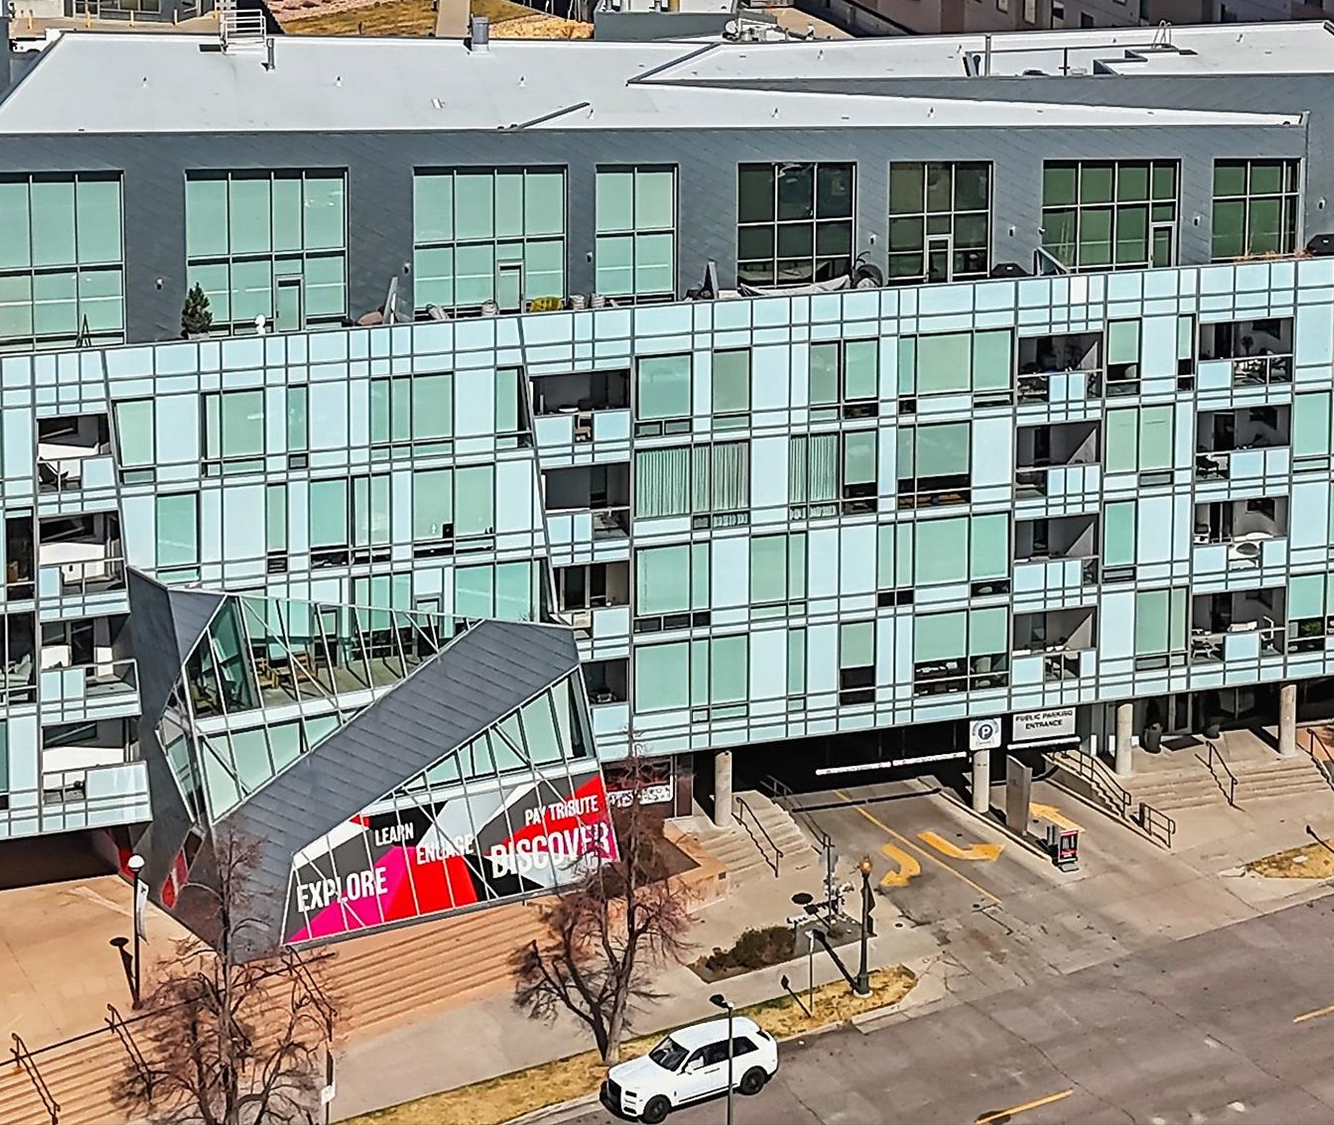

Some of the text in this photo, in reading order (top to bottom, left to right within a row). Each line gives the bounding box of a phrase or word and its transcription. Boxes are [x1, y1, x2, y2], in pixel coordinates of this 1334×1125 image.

[1025, 719, 1063, 729] ENTRANCE
[525, 806, 546, 826] PAY
[548, 795, 599, 821] TRIBUTE
[375, 821, 414, 846] LEARN
[297, 867, 388, 912] EXPLORE
